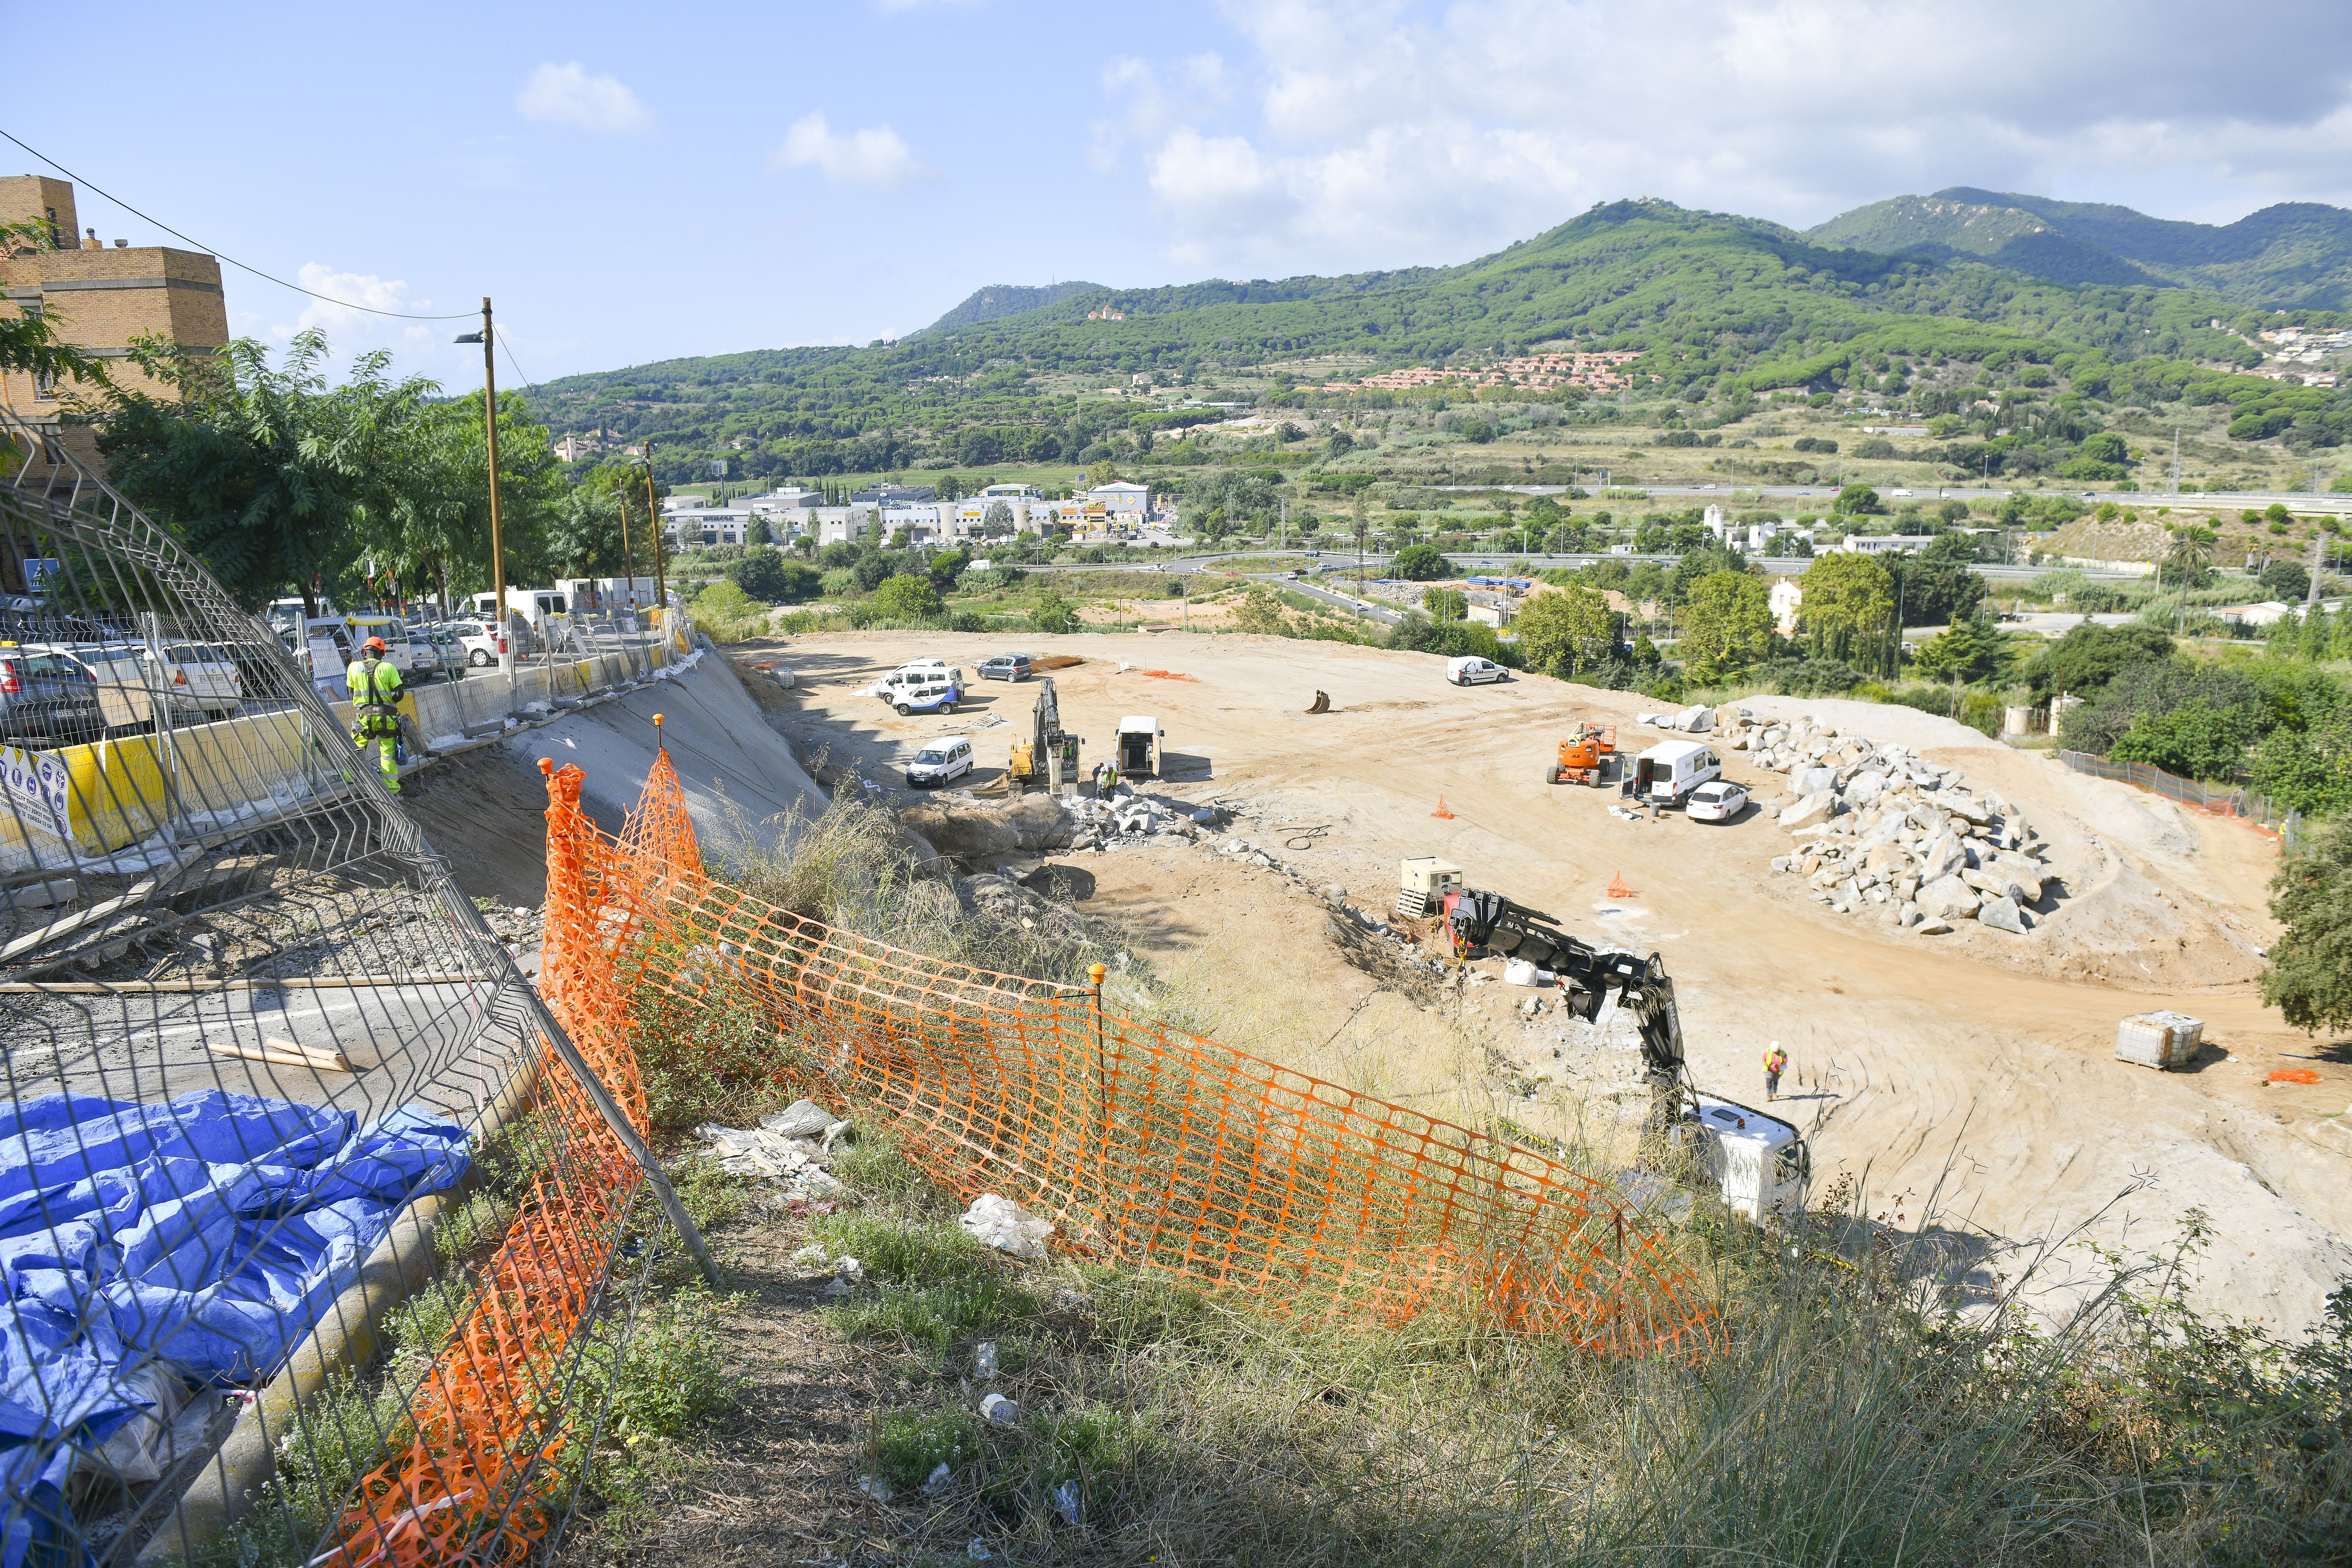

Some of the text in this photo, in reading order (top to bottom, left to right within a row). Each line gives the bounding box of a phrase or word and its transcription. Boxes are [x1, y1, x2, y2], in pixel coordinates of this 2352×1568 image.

[26, 798, 42, 811] PERSONA
[31, 808, 42, 817] SENSE
[42, 807, 52, 816] D'UNA
[43, 814, 52, 822] OBRA
